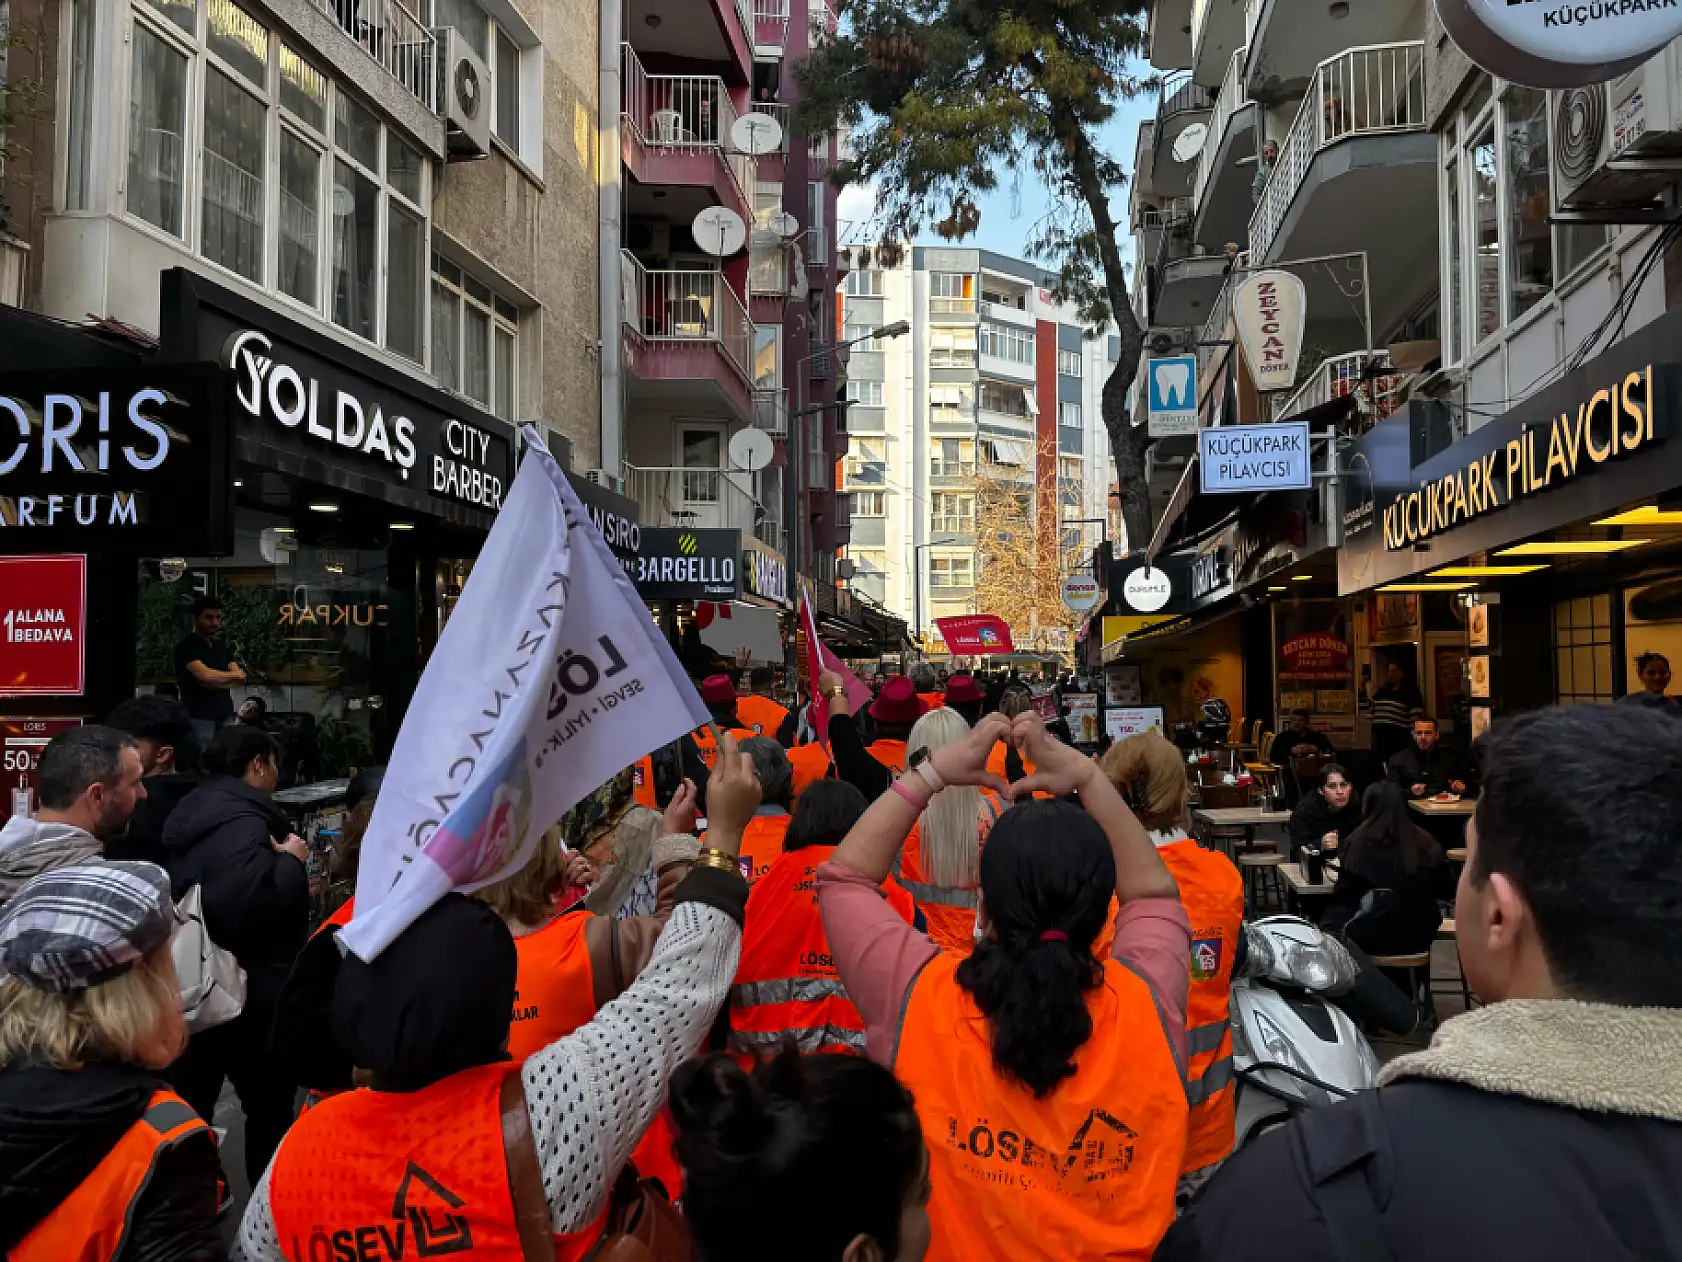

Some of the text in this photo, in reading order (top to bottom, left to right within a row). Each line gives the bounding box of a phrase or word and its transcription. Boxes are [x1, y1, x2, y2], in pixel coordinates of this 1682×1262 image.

[1257, 281, 1284, 361] ZEYCAN
[1260, 363, 1290, 373] DÖNER
[446, 420, 490, 466] CITY
[1208, 434, 1302, 459] KÜÇÜKPARK
[1384, 364, 1653, 551] KÜÇÜKPARK PİLAVCISI
[433, 453, 501, 511] BARBER
[1219, 459, 1291, 480] PİLAVCISI
[0, 492, 138, 526] RFUM
[585, 503, 640, 552] NSİRO
[638, 557, 735, 582] BARGELLO
[4, 608, 66, 643] 1 ALANA
[14, 628, 74, 643] BEDAVA
[3, 750, 31, 772] 50
